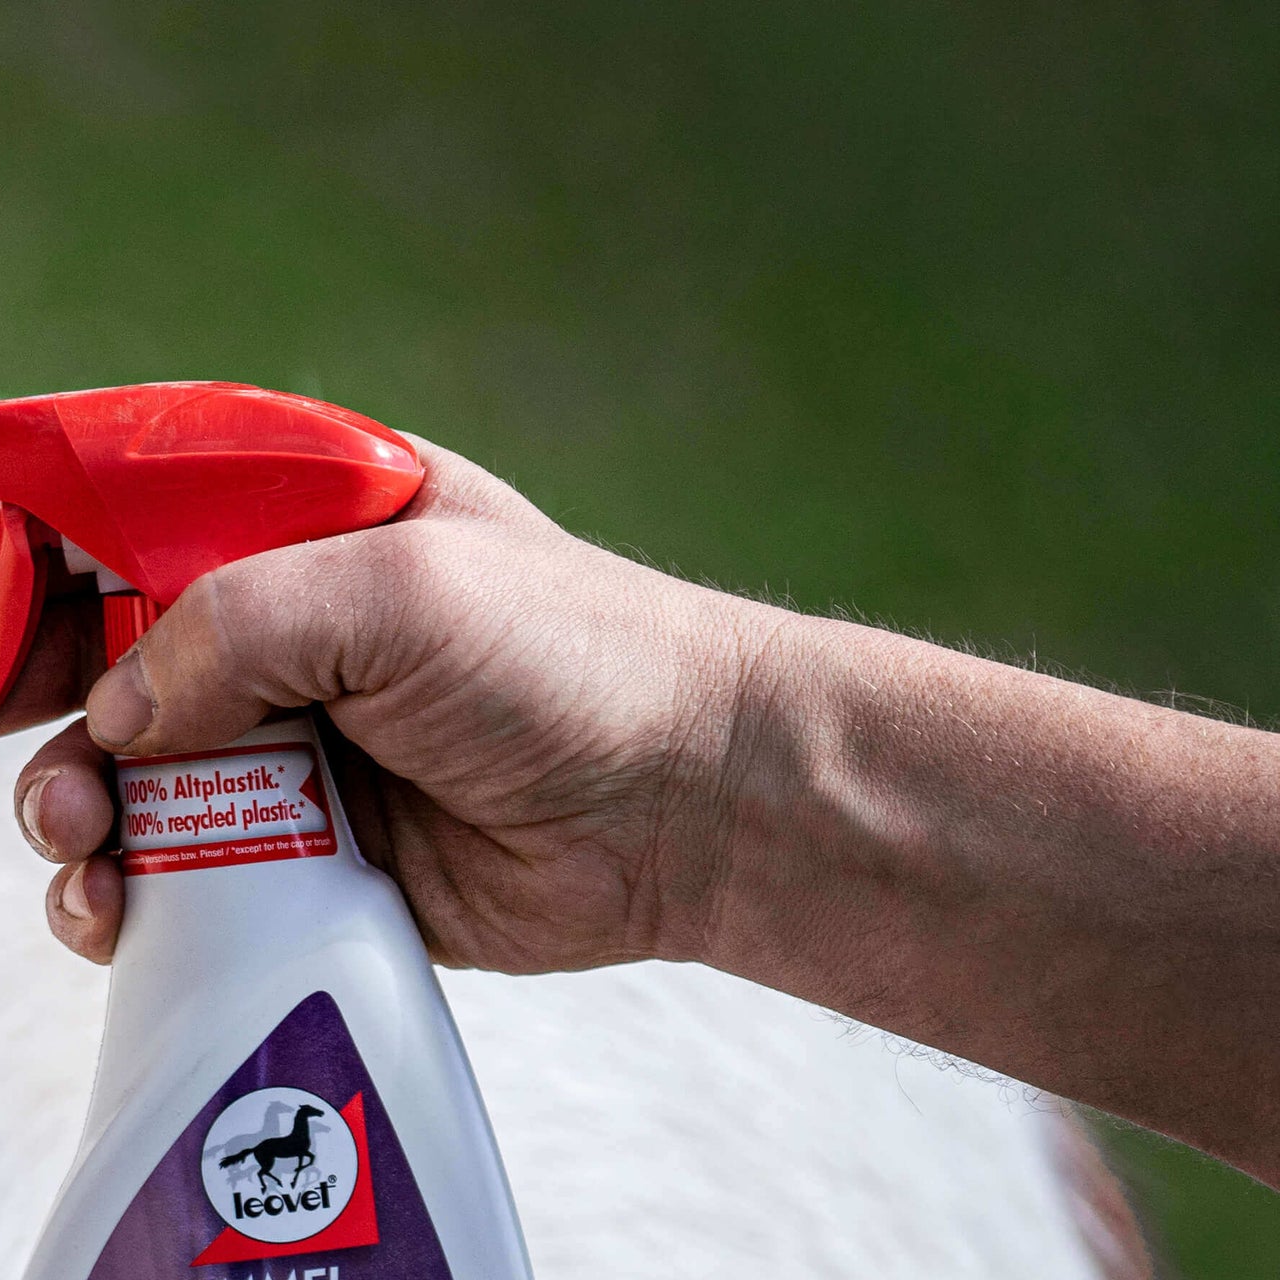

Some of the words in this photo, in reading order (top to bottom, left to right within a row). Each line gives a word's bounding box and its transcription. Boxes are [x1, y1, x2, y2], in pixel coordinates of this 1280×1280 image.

[125, 777, 168, 805] 100%
[126, 810, 164, 837] 100%
[168, 801, 237, 836] recycled
[200, 847, 224, 859] Pinsel
[264, 842, 275, 851] for
[277, 840, 290, 849] the
[291, 840, 305, 849] cap
